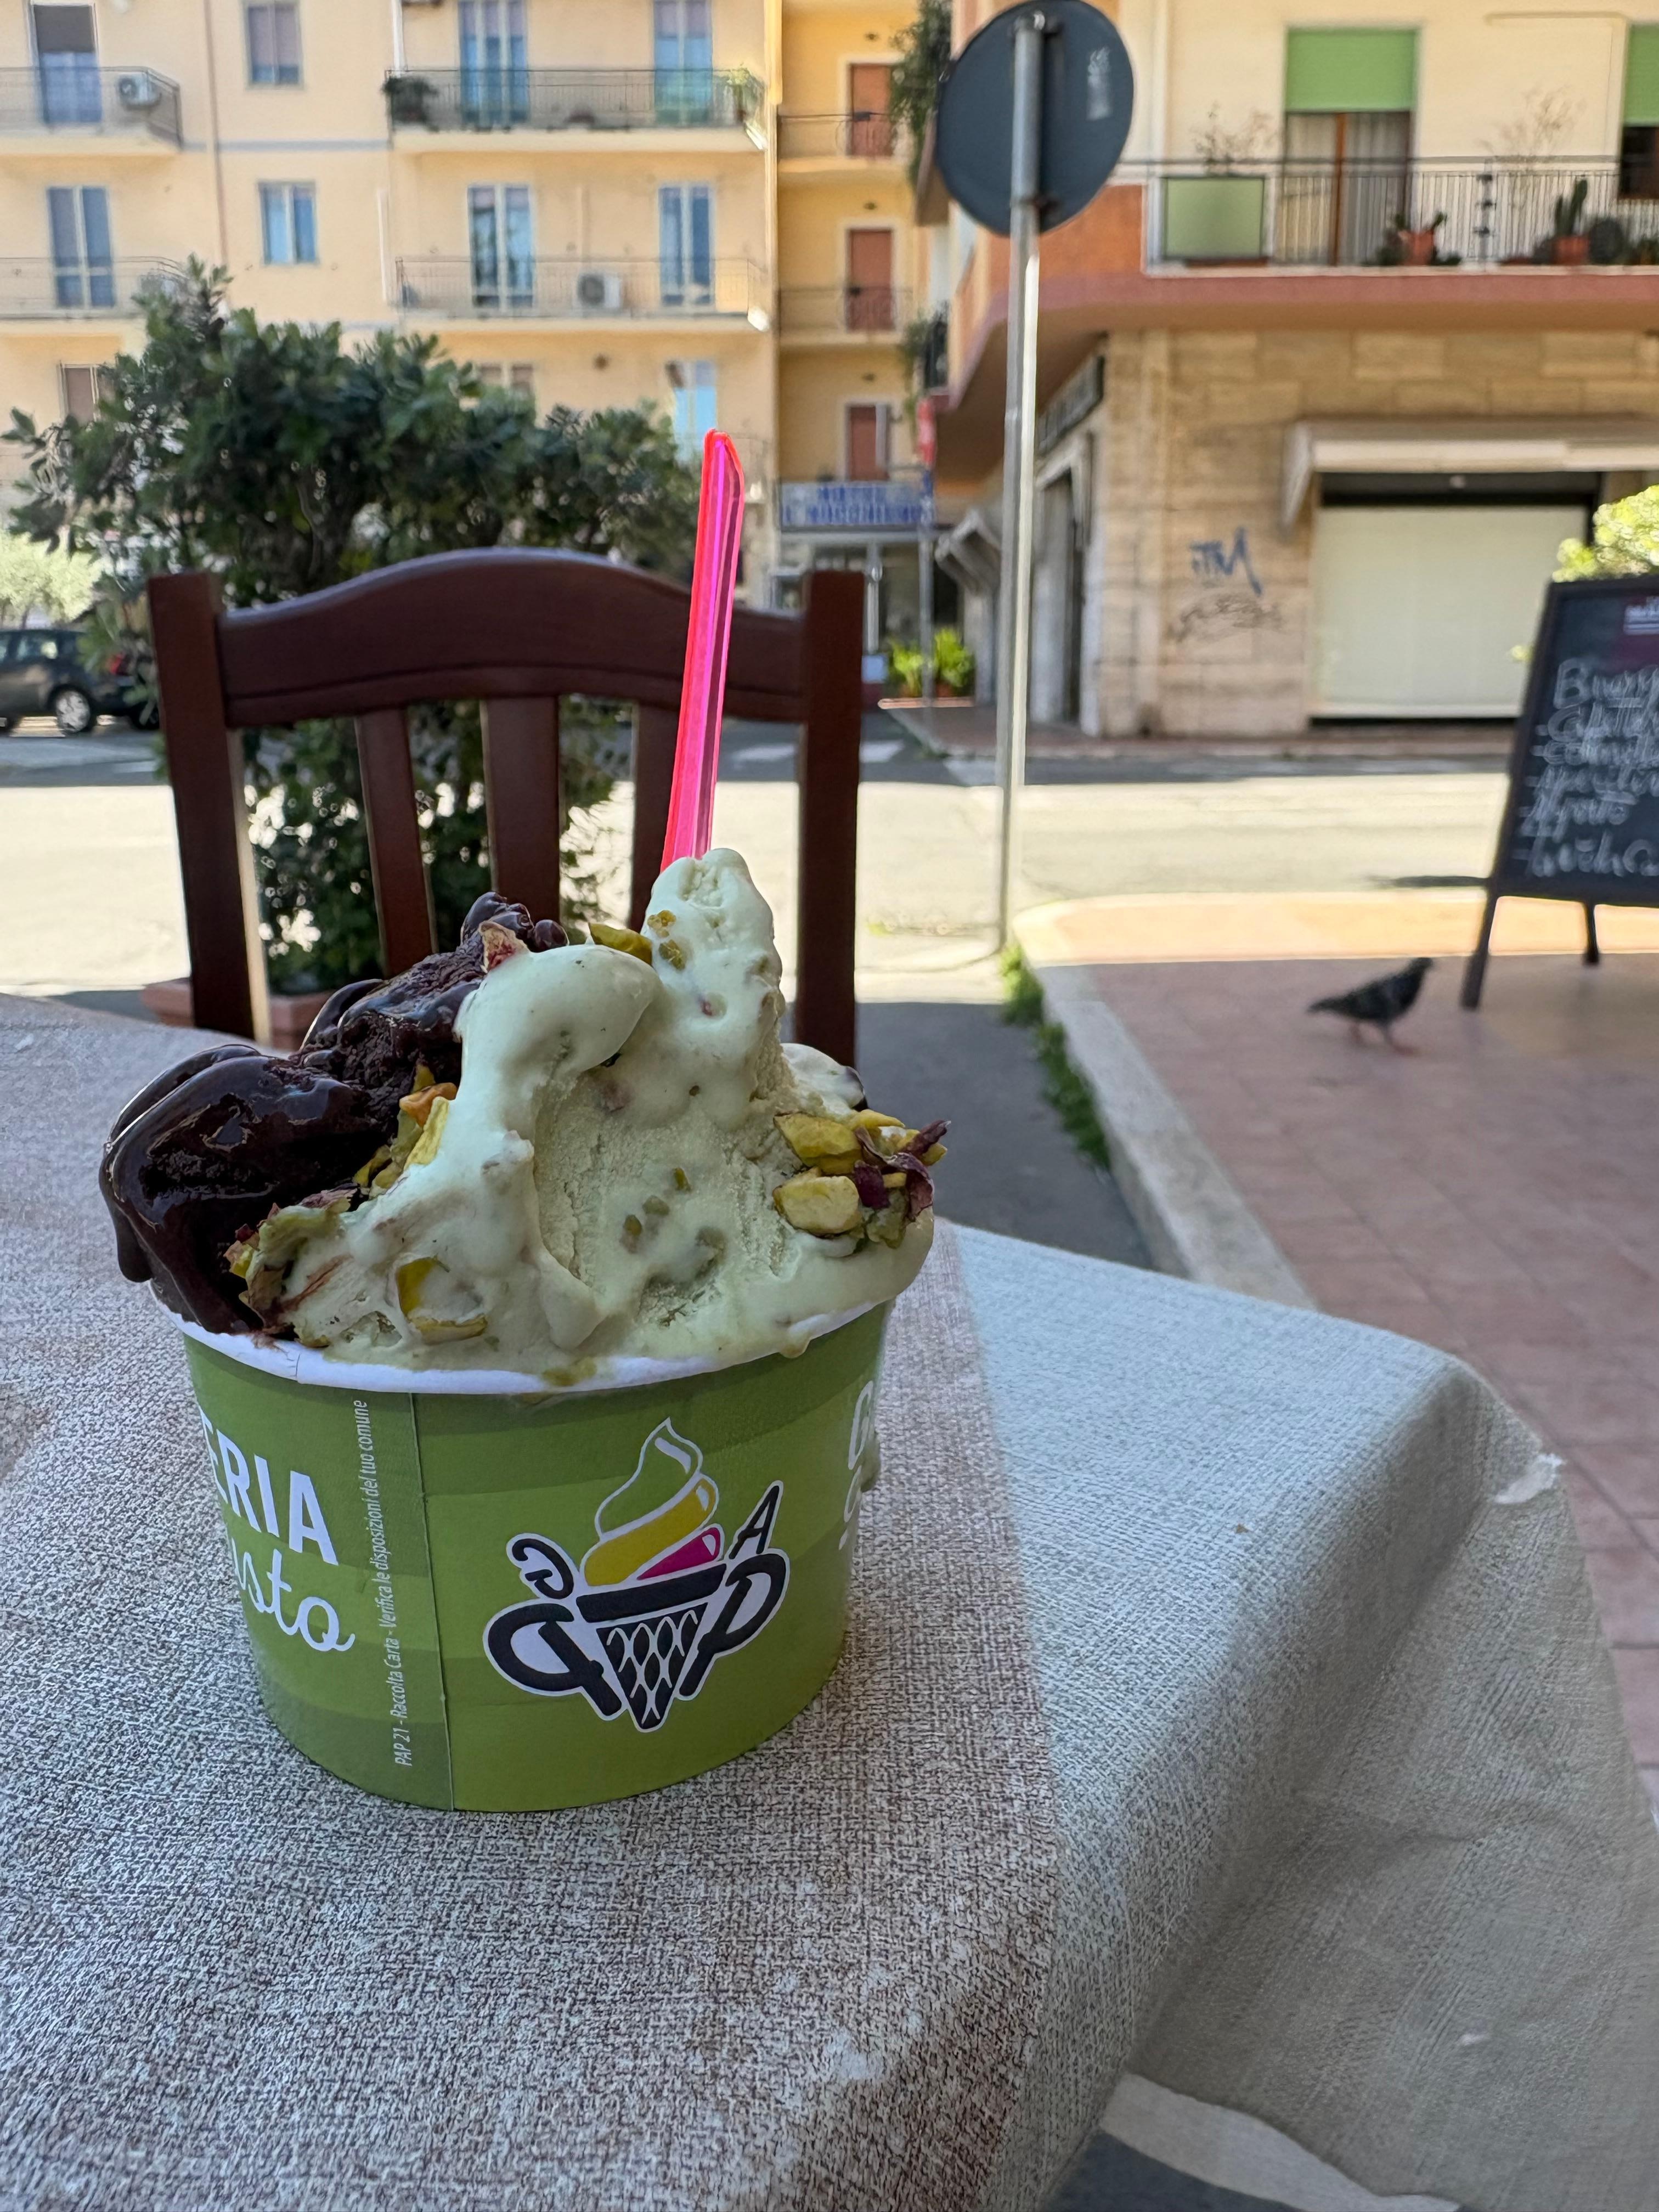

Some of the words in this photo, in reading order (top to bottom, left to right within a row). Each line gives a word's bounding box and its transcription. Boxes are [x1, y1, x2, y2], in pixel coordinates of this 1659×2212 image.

[353, 1400, 373, 1451] comune
[360, 1453, 376, 1475] tuo
[358, 1475, 379, 1497] del
[361, 1498, 392, 1570] disposizioni
[371, 1572, 392, 1584] le
[374, 1586, 397, 1627] Verifica
[383, 1638, 402, 1669] Carta
[386, 1671, 408, 1719] Raccolta
[393, 1728, 410, 1743] 21
[394, 1743, 412, 1767] PAP
